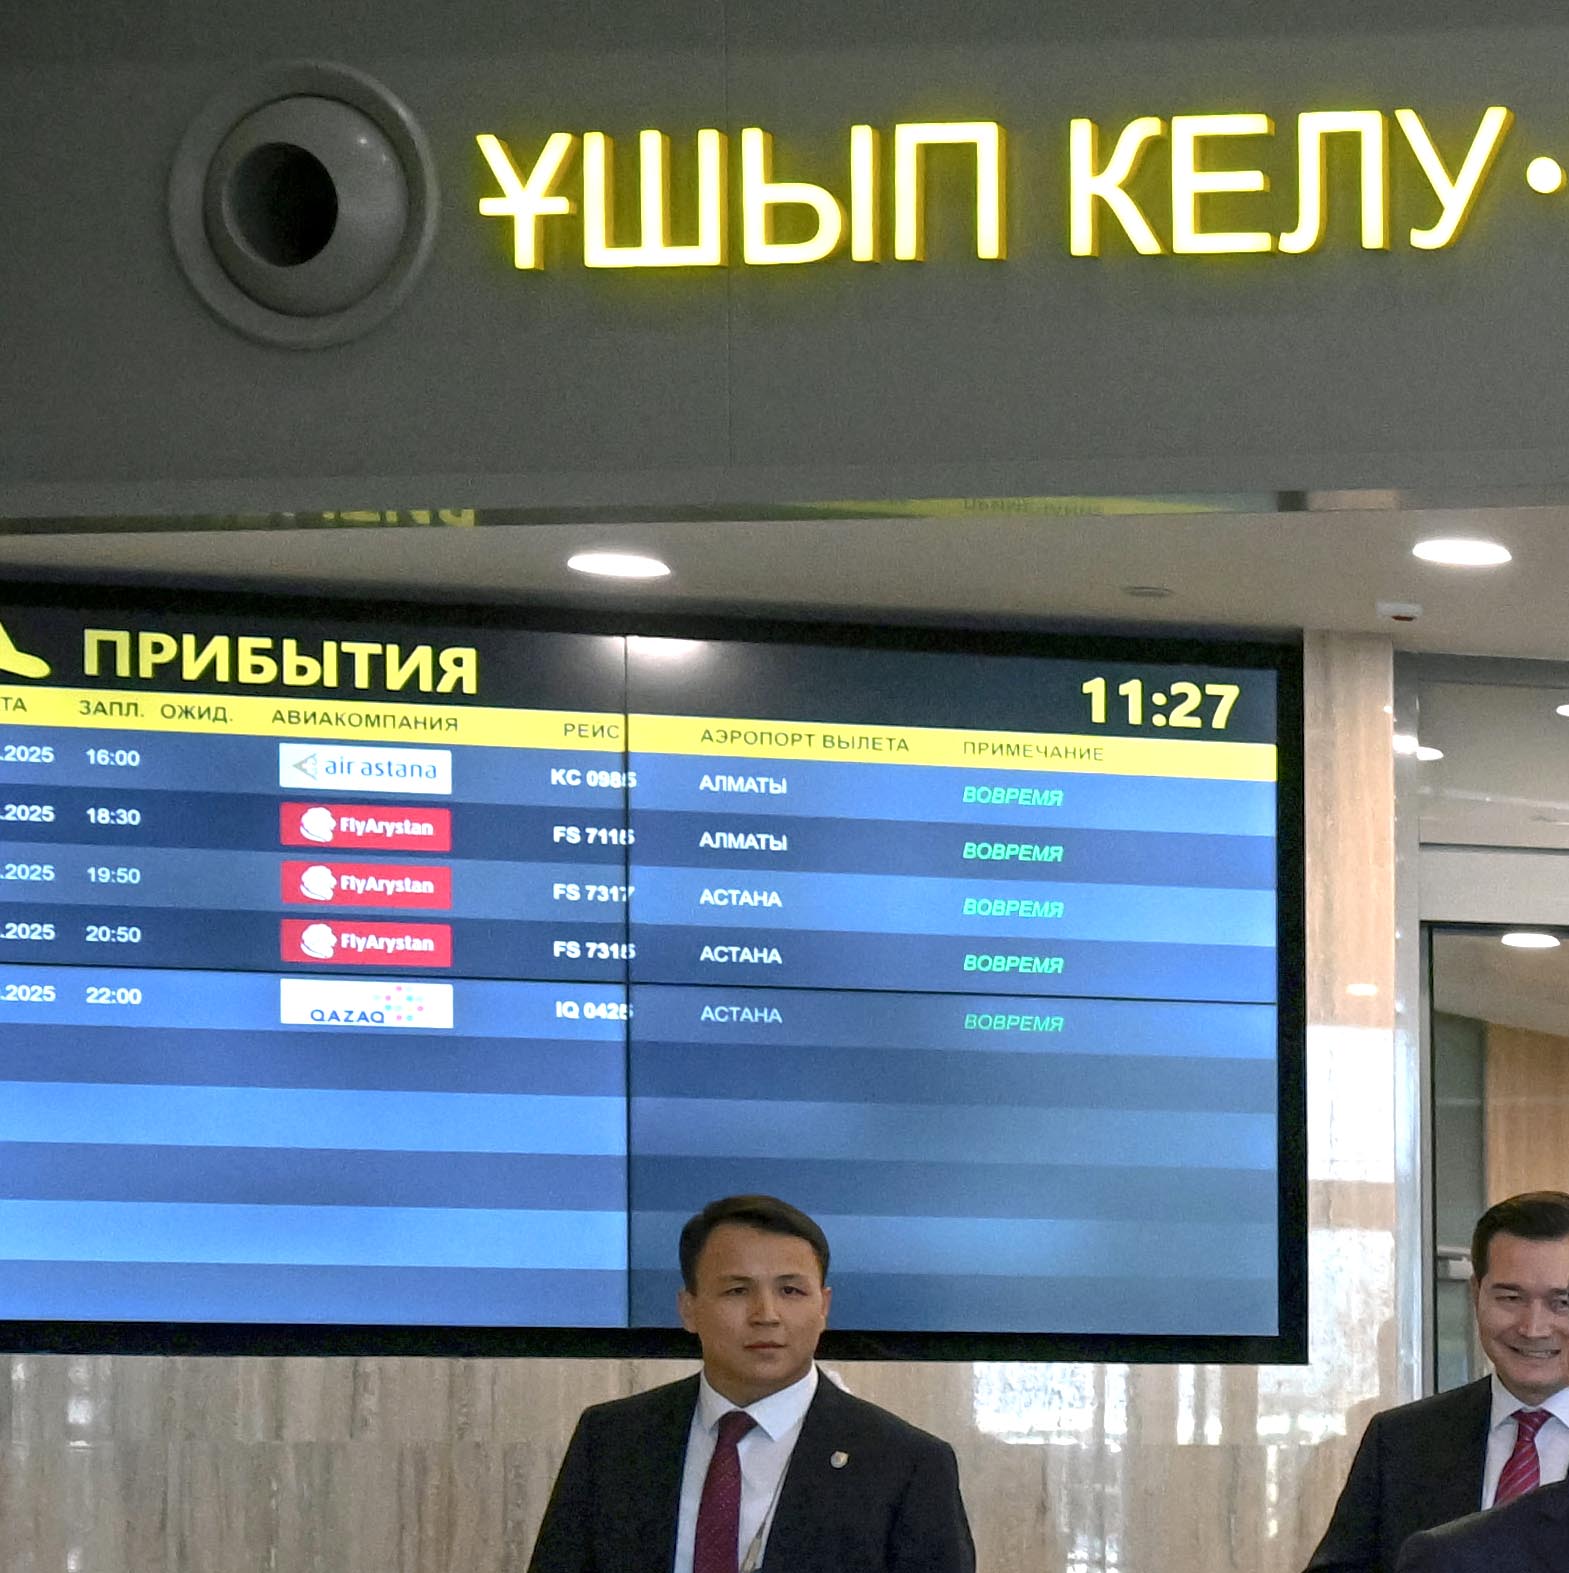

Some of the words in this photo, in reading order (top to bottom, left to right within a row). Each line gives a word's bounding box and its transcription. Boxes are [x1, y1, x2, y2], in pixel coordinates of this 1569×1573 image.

[475, 119, 1004, 271] ҰШЫП
[1068, 106, 1512, 257] КЕЛУ
[84, 627, 478, 694] ПРИБЫТИЯ
[79, 699, 145, 717] ЗАПЛ.
[160, 703, 233, 724] ОЖИД.
[271, 708, 459, 732] АВИАКОМПАНИЯ
[700, 727, 815, 749] АЭРОПОРТ
[822, 733, 910, 753] ВЫЛЕТА
[962, 741, 1105, 761] ПРИМЕЧАНИЕ
[1081, 677, 1240, 730] 11:27
[86, 748, 140, 767] 16:00
[325, 756, 354, 775] air
[361, 761, 437, 779] astana
[551, 769, 581, 786] KC
[699, 774, 787, 795] АЛМАТЫ
[962, 785, 1063, 807] ВОВРЕМЯ
[86, 808, 141, 825] 18:30
[340, 817, 434, 837] FlyArystan
[553, 826, 581, 843] FS
[699, 831, 787, 852] АЛМАТЫ
[962, 842, 1063, 862] ВОВРЕМЯ
[87, 867, 141, 884] 19:50
[340, 875, 434, 895] FlyArystan
[553, 883, 581, 901] FS
[699, 888, 783, 907] АСТАНА
[962, 898, 1064, 919] ВОВРЕМЯ
[86, 926, 141, 943] 20:50
[340, 934, 434, 953] FlyArystan
[553, 941, 581, 958] FS
[700, 946, 783, 964] АСТАНА
[963, 954, 1064, 974] ВОВРЕМЯ
[86, 987, 142, 1005] 22:00
[310, 1009, 384, 1024] QAZAQ
[555, 1001, 579, 1020] IQ
[700, 1005, 783, 1024] АСТАНА
[964, 1014, 1064, 1033] ВОВРЕМЯ
